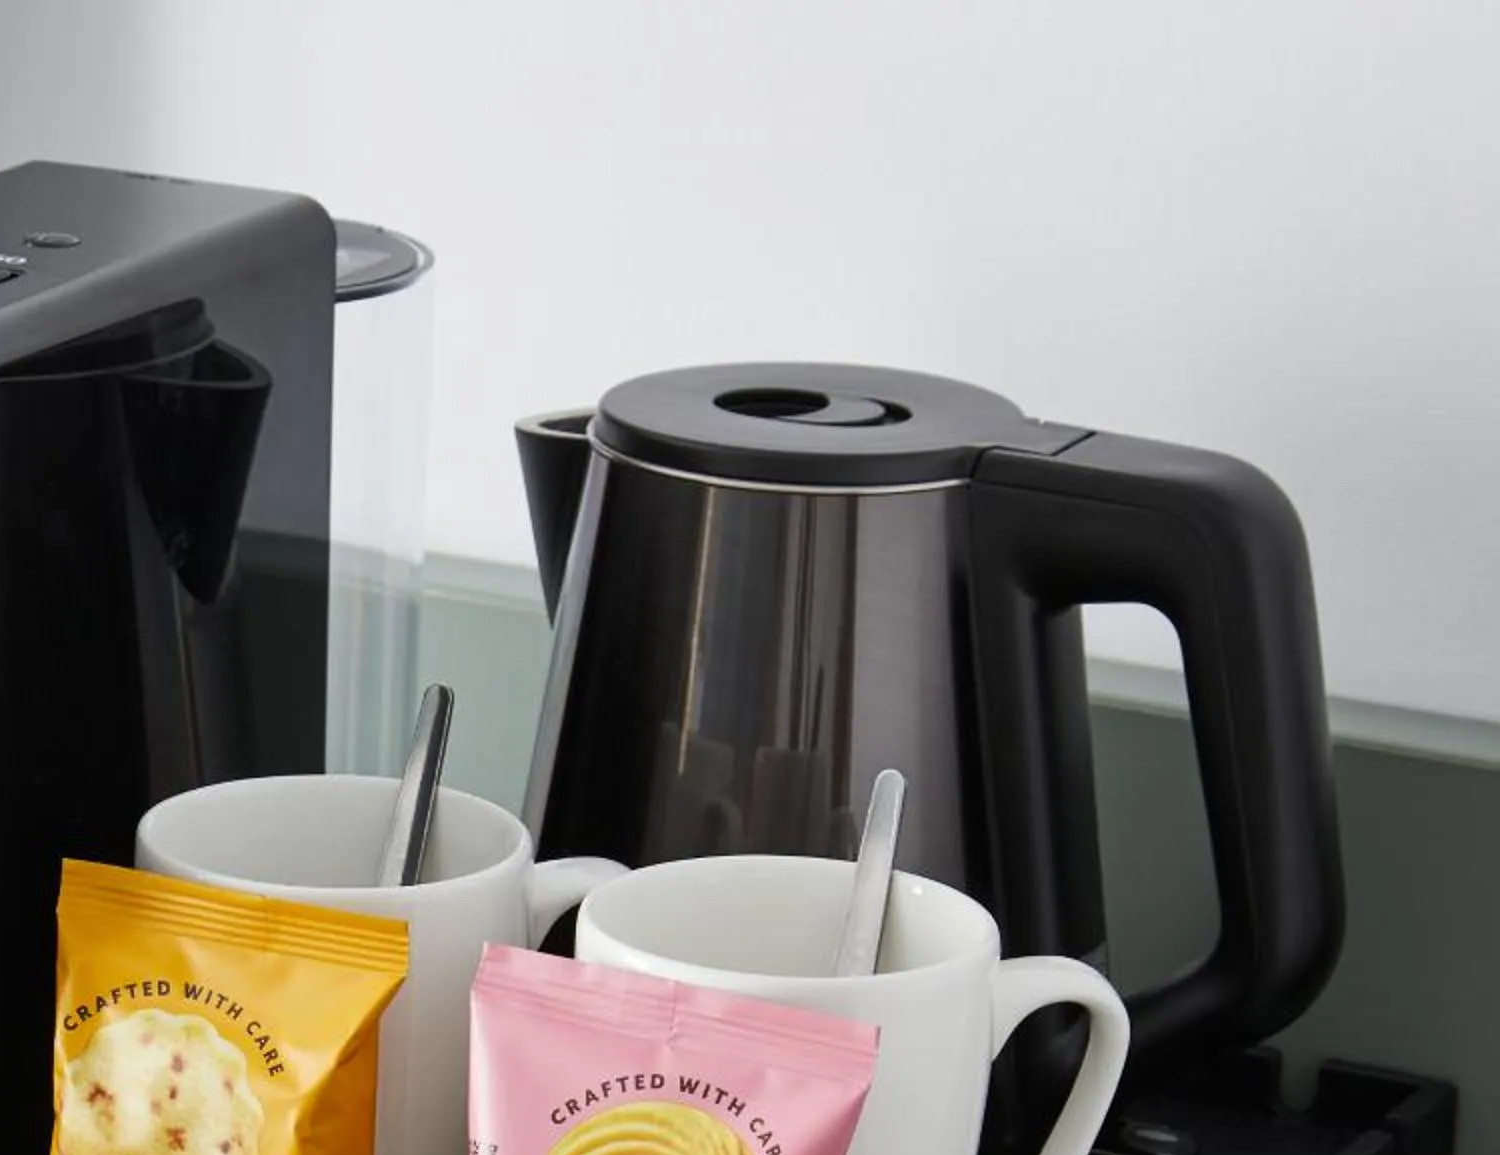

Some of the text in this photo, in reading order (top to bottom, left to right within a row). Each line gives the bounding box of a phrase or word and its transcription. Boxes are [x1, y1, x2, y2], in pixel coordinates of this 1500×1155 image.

[62, 980, 285, 1078] CRAFTED WITH CARE
[550, 1073, 665, 1126] CRAFTED
[678, 1075, 746, 1117] WITH
